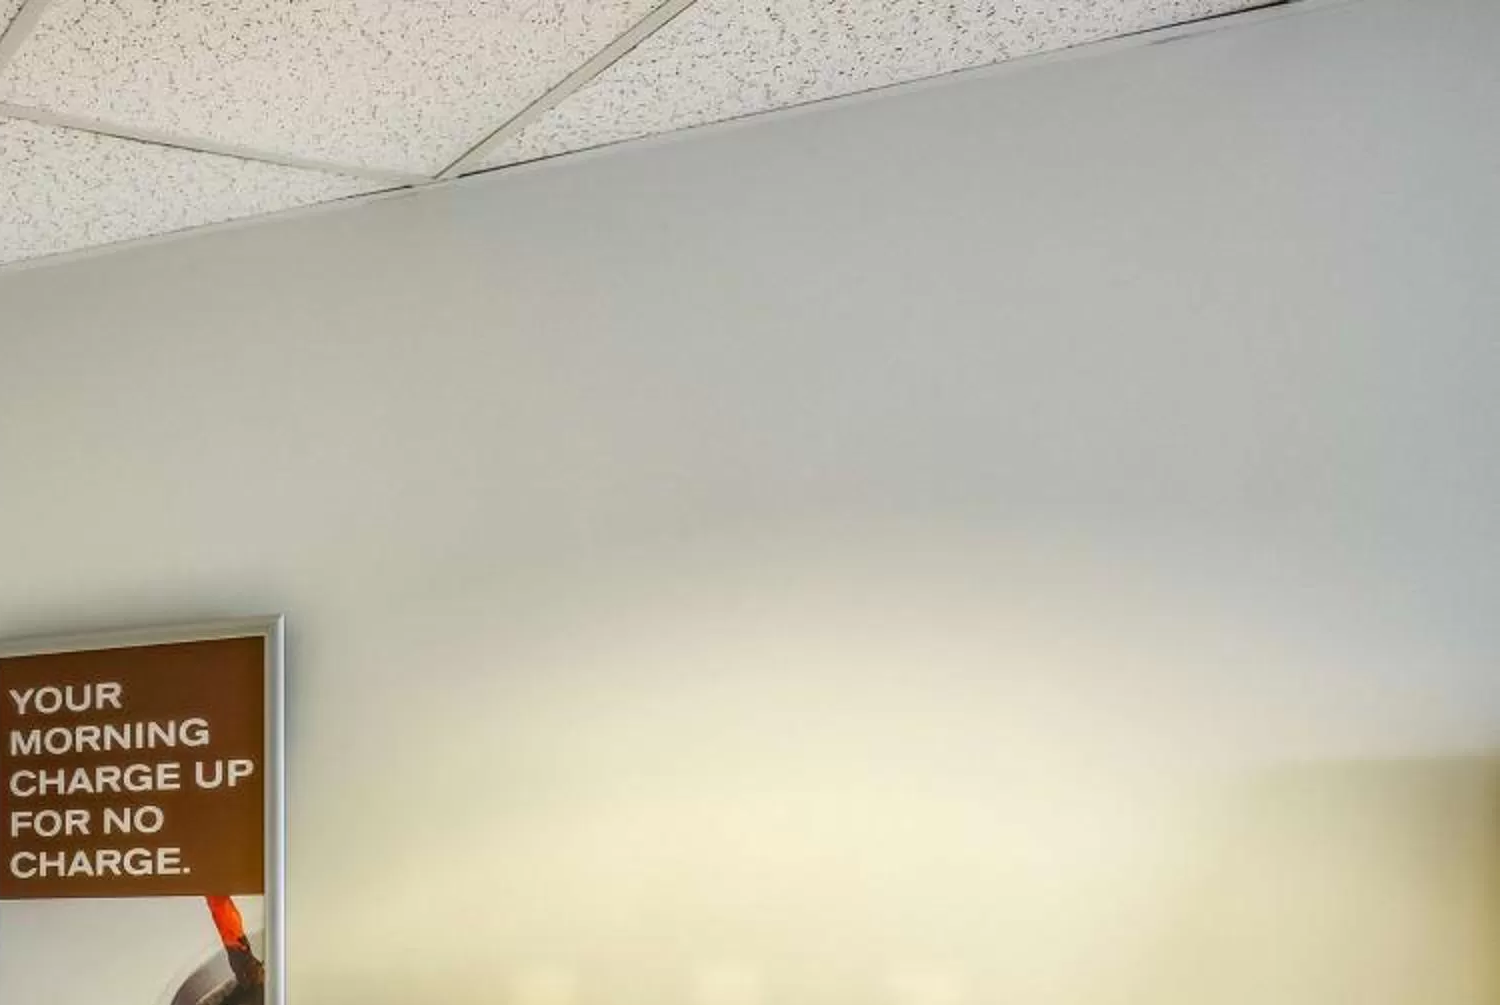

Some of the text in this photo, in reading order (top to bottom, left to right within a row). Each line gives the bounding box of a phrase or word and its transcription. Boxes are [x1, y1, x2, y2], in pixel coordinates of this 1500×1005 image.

[8, 681, 123, 715] YOUR
[9, 717, 209, 756] MORNING
[8, 759, 255, 798] CHARGE UP
[10, 805, 164, 838] FOR NO
[9, 847, 192, 879] CHARGE.
